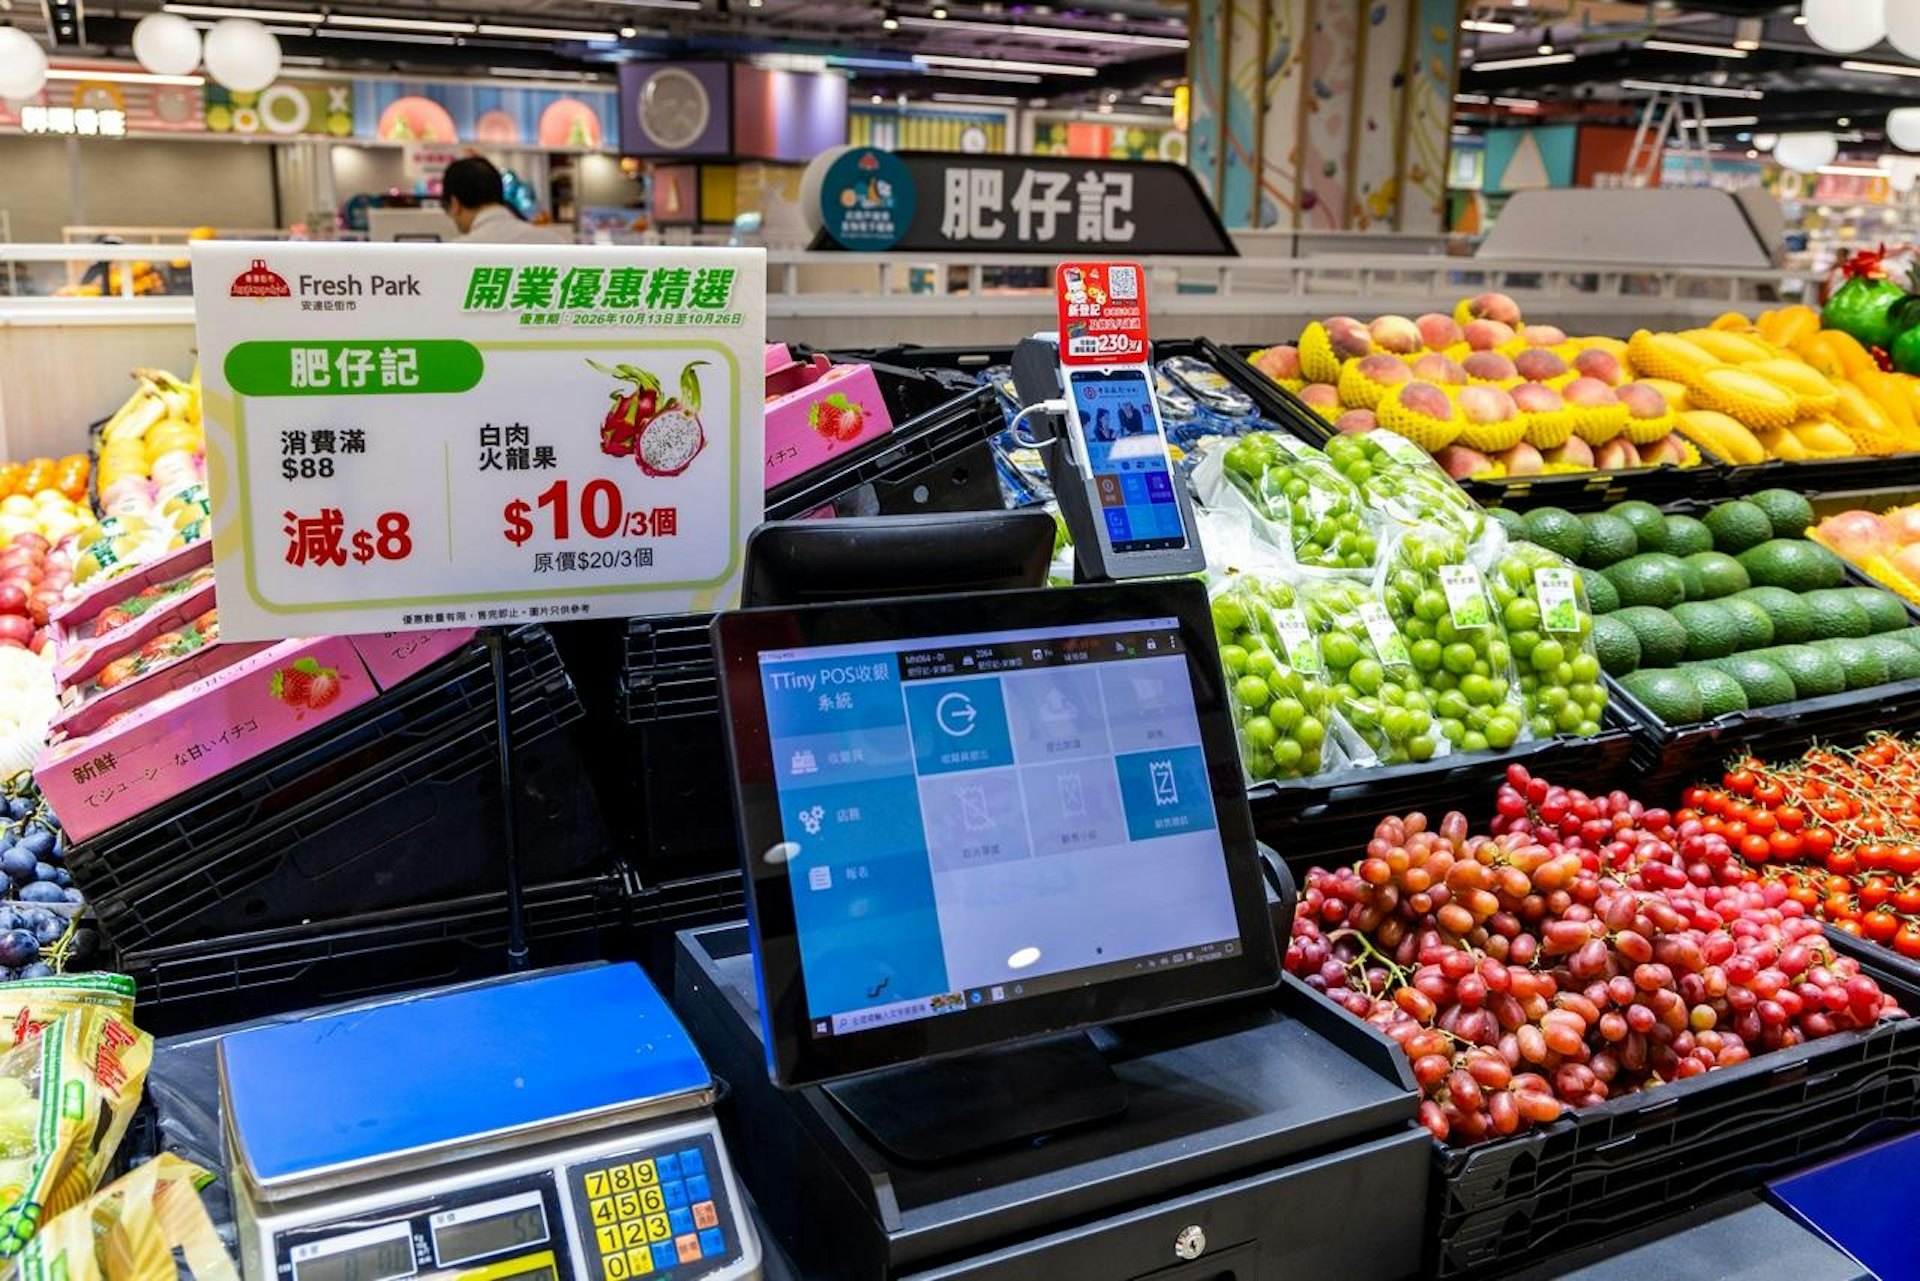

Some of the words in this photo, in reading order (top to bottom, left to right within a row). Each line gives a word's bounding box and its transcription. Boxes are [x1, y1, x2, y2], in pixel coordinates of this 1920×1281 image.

[941, 168, 1135, 242] 肥仔記
[299, 274, 362, 296] Fresh
[372, 274, 421, 296] Park
[462, 266, 735, 310] 開業優惠精選
[290, 346, 419, 388] 肥仔記
[281, 429, 366, 455] 消費滿
[480, 423, 529, 446] 白肉
[282, 457, 335, 481] $88
[479, 446, 557, 470] 火龍果
[533, 547, 653, 573] 原價$20/3個
[769, 672, 816, 693] TTiny
[71, 751, 118, 785] 新鮮
[589, 1174, 603, 1195] 7
[614, 1169, 630, 1189] 8
[637, 1164, 653, 1183] 9
[597, 1202, 612, 1221] 4
[621, 1196, 636, 1215] 5
[645, 1190, 660, 1210] 6
[604, 1229, 616, 1248] 1
[627, 1224, 643, 1244] 2
[652, 1218, 667, 1237] 3
[609, 1257, 624, 1277] 0
